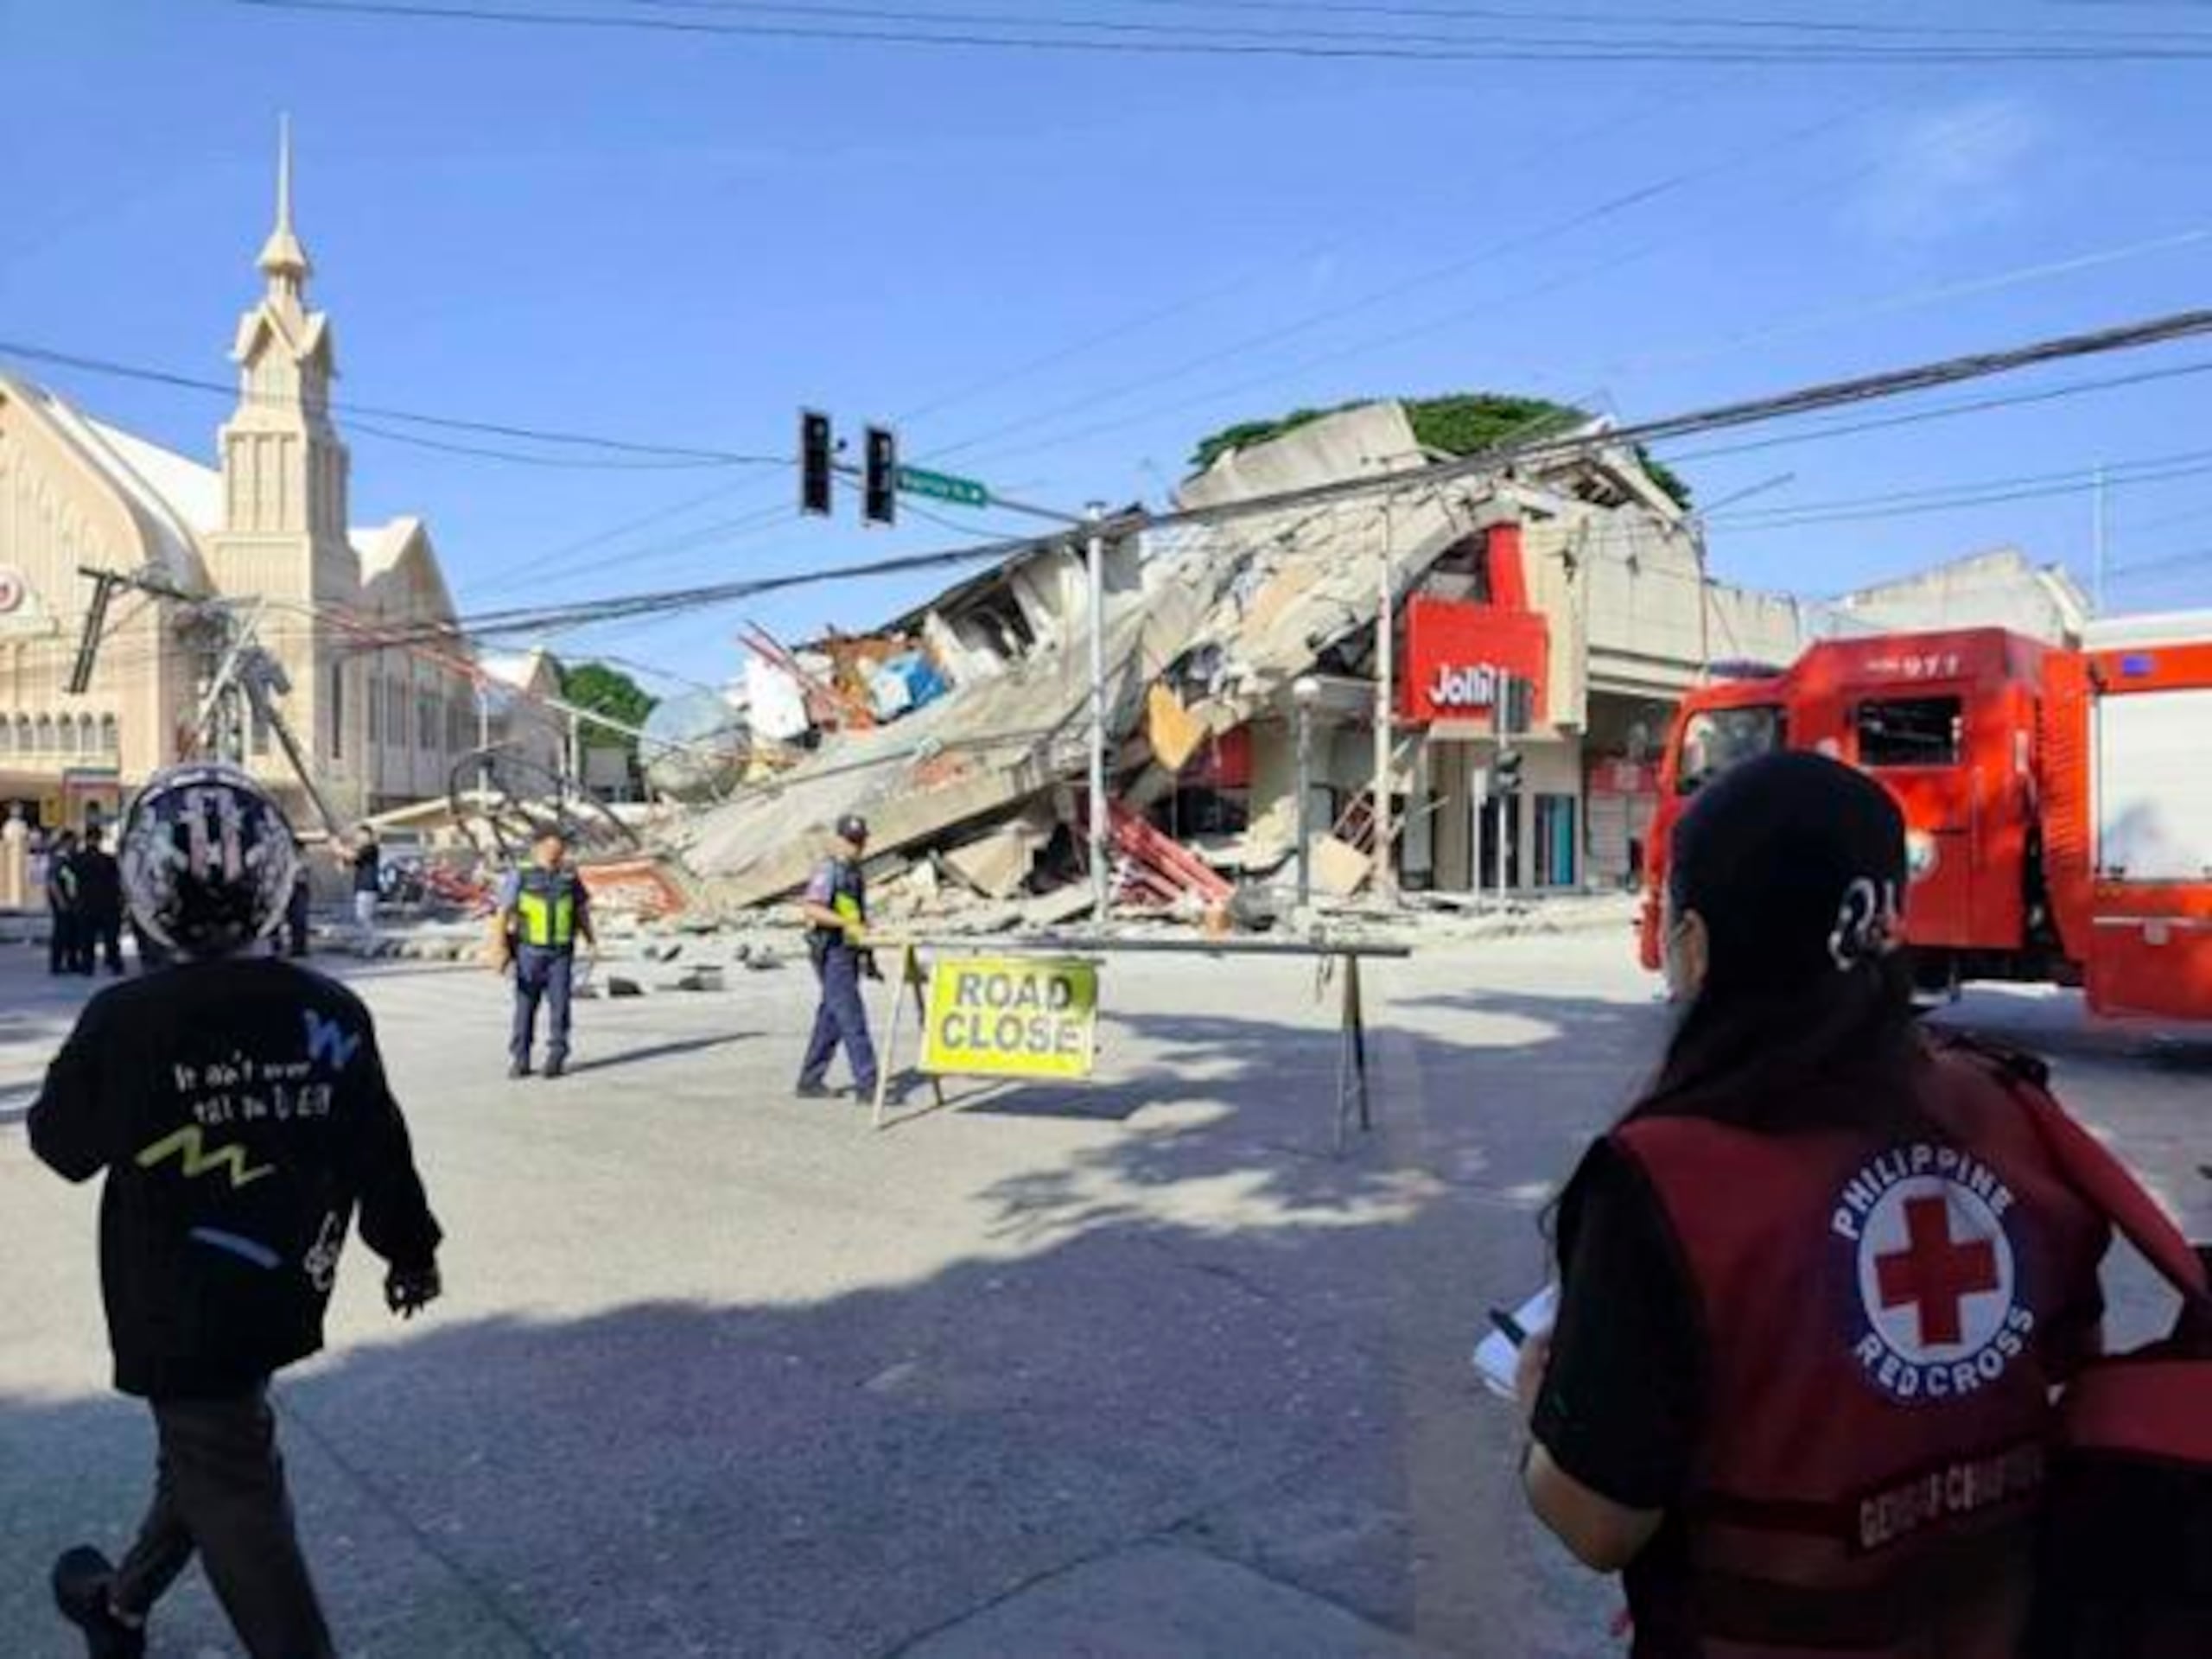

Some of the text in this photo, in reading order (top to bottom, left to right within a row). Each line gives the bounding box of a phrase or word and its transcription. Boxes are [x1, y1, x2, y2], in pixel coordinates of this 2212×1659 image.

[1427, 661, 1497, 707] Jolli
[957, 972, 1073, 1010] ROAD
[942, 1012, 1080, 1053] CLOSE
[1831, 1144, 2015, 1241] PHILIPPINE
